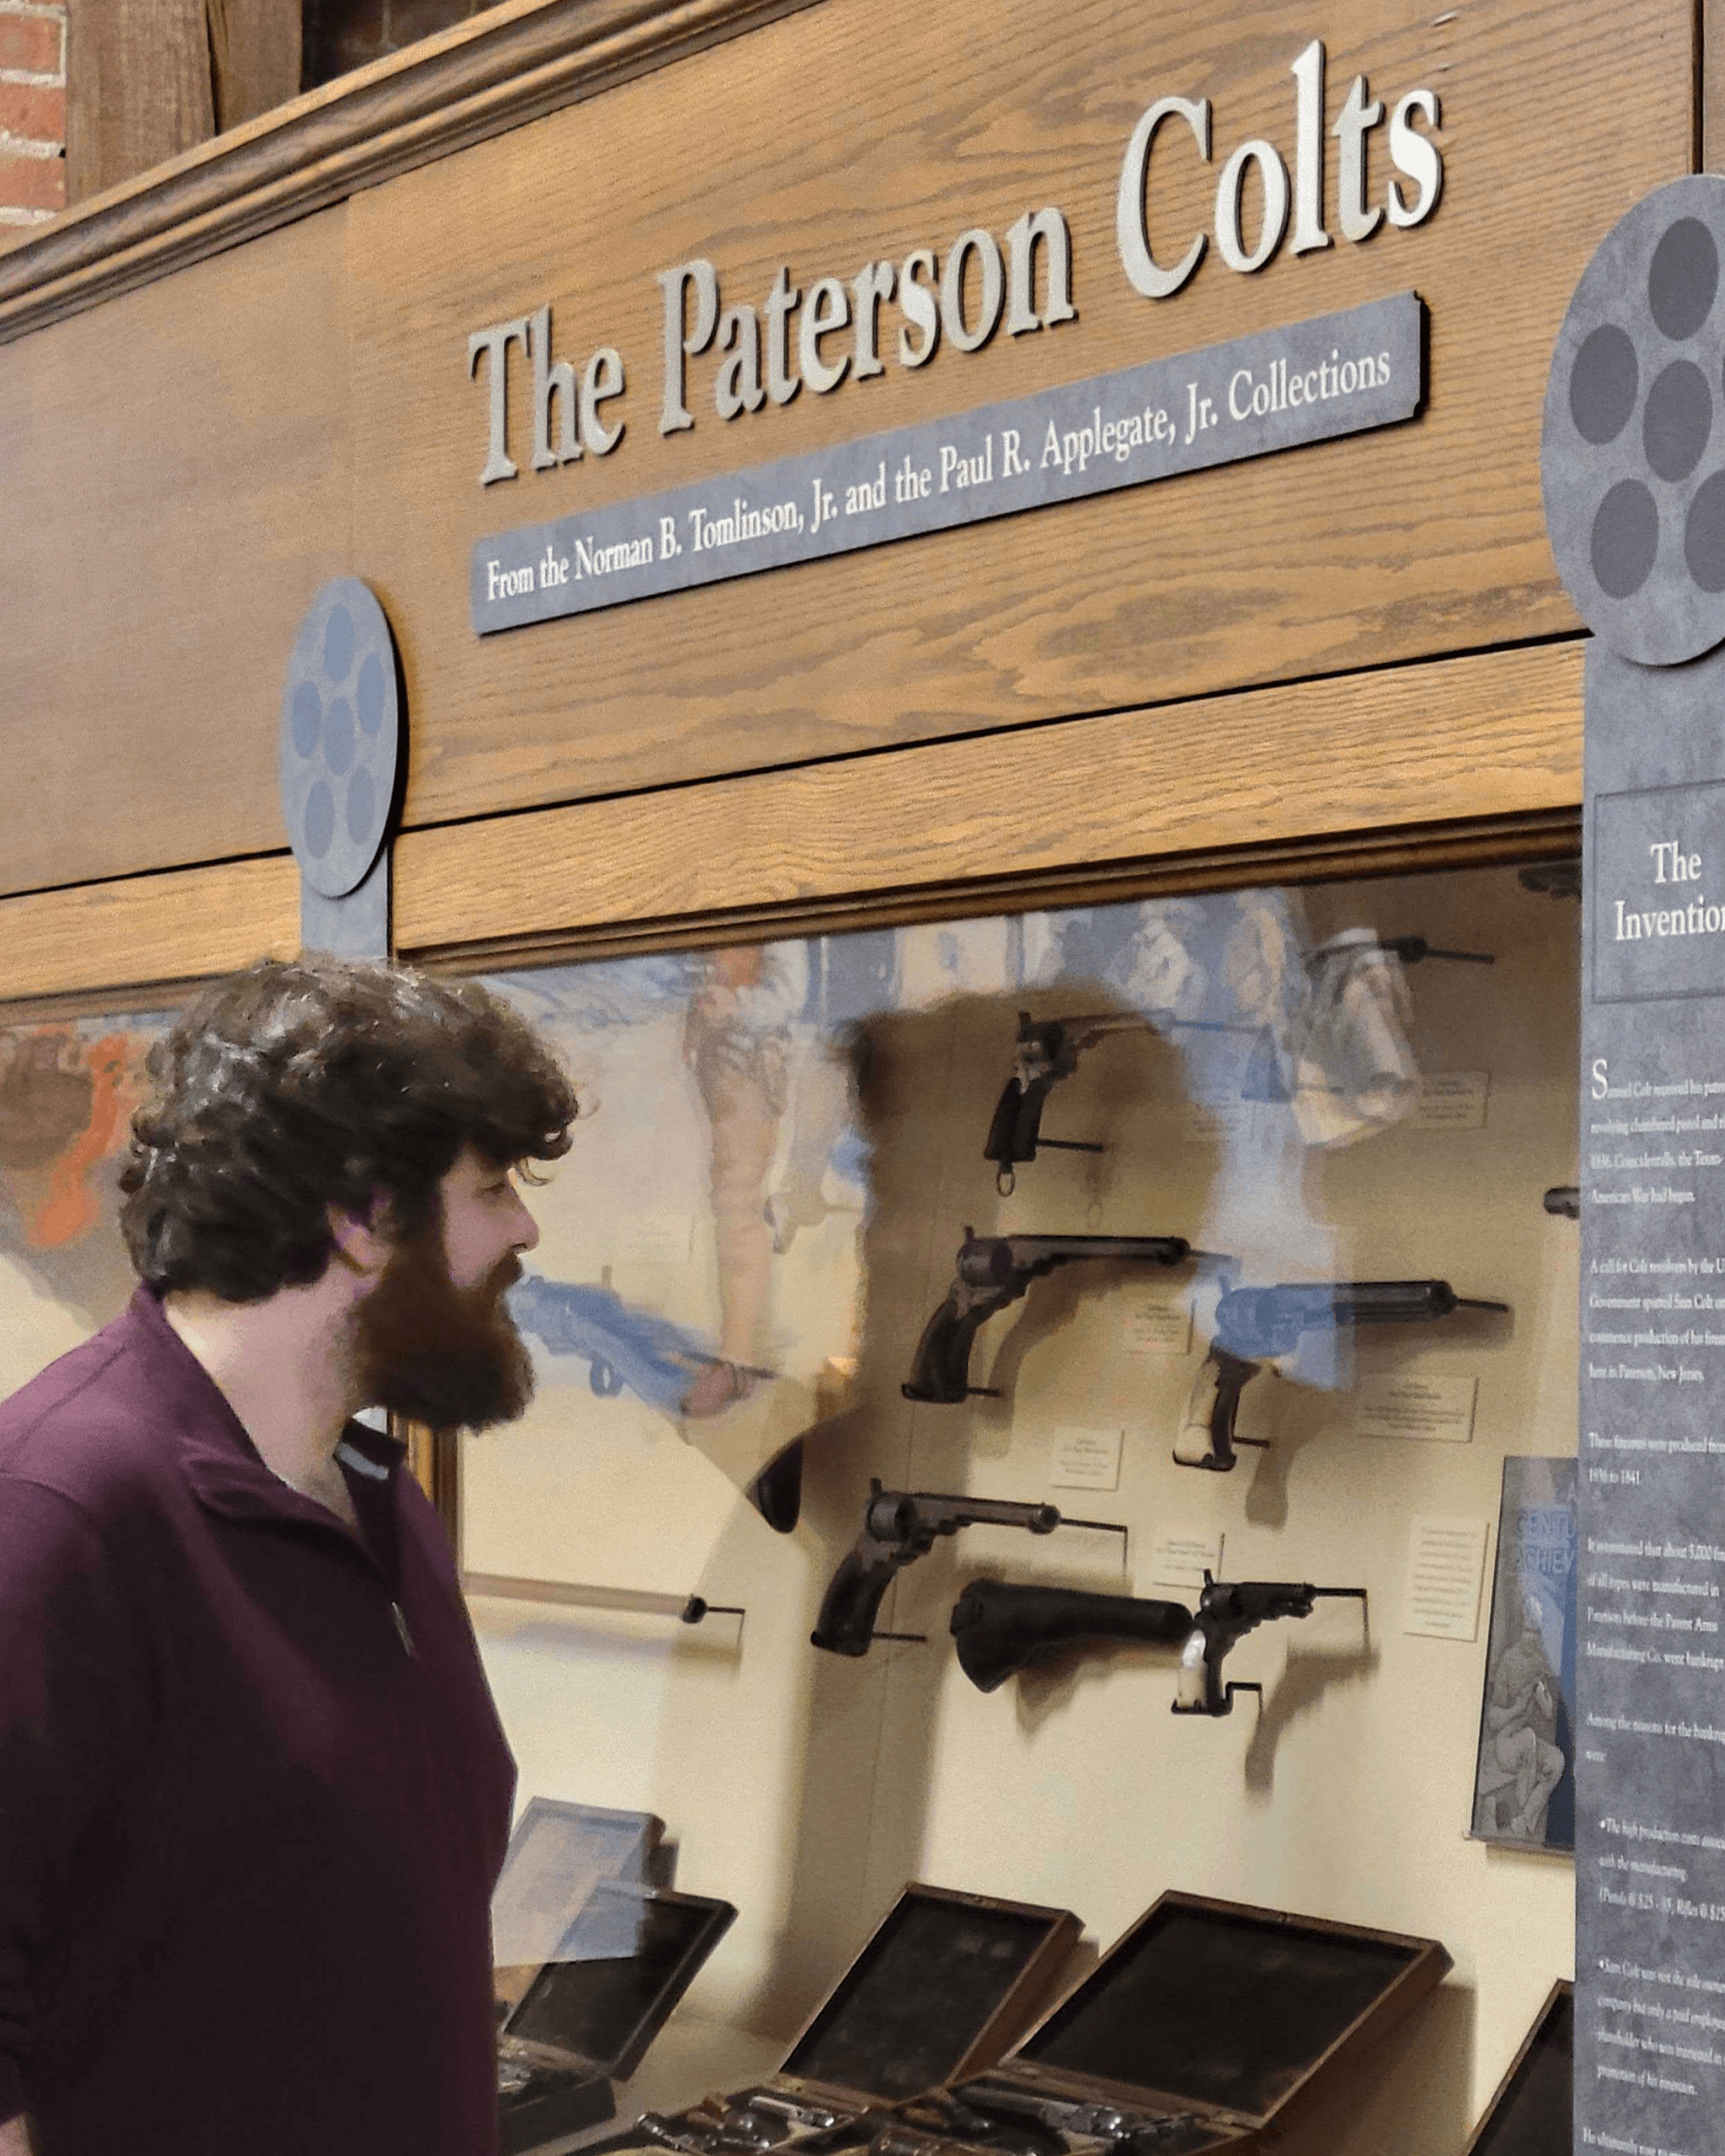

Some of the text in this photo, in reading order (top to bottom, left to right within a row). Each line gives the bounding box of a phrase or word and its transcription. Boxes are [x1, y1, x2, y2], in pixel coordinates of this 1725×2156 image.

[469, 40, 1441, 486] The Paterson Colts
[486, 348, 1391, 601] From the Norman B. Tomlinson, Jr. and the Paul R. Applegate, Jr. Collections
[1650, 840, 1703, 884] The
